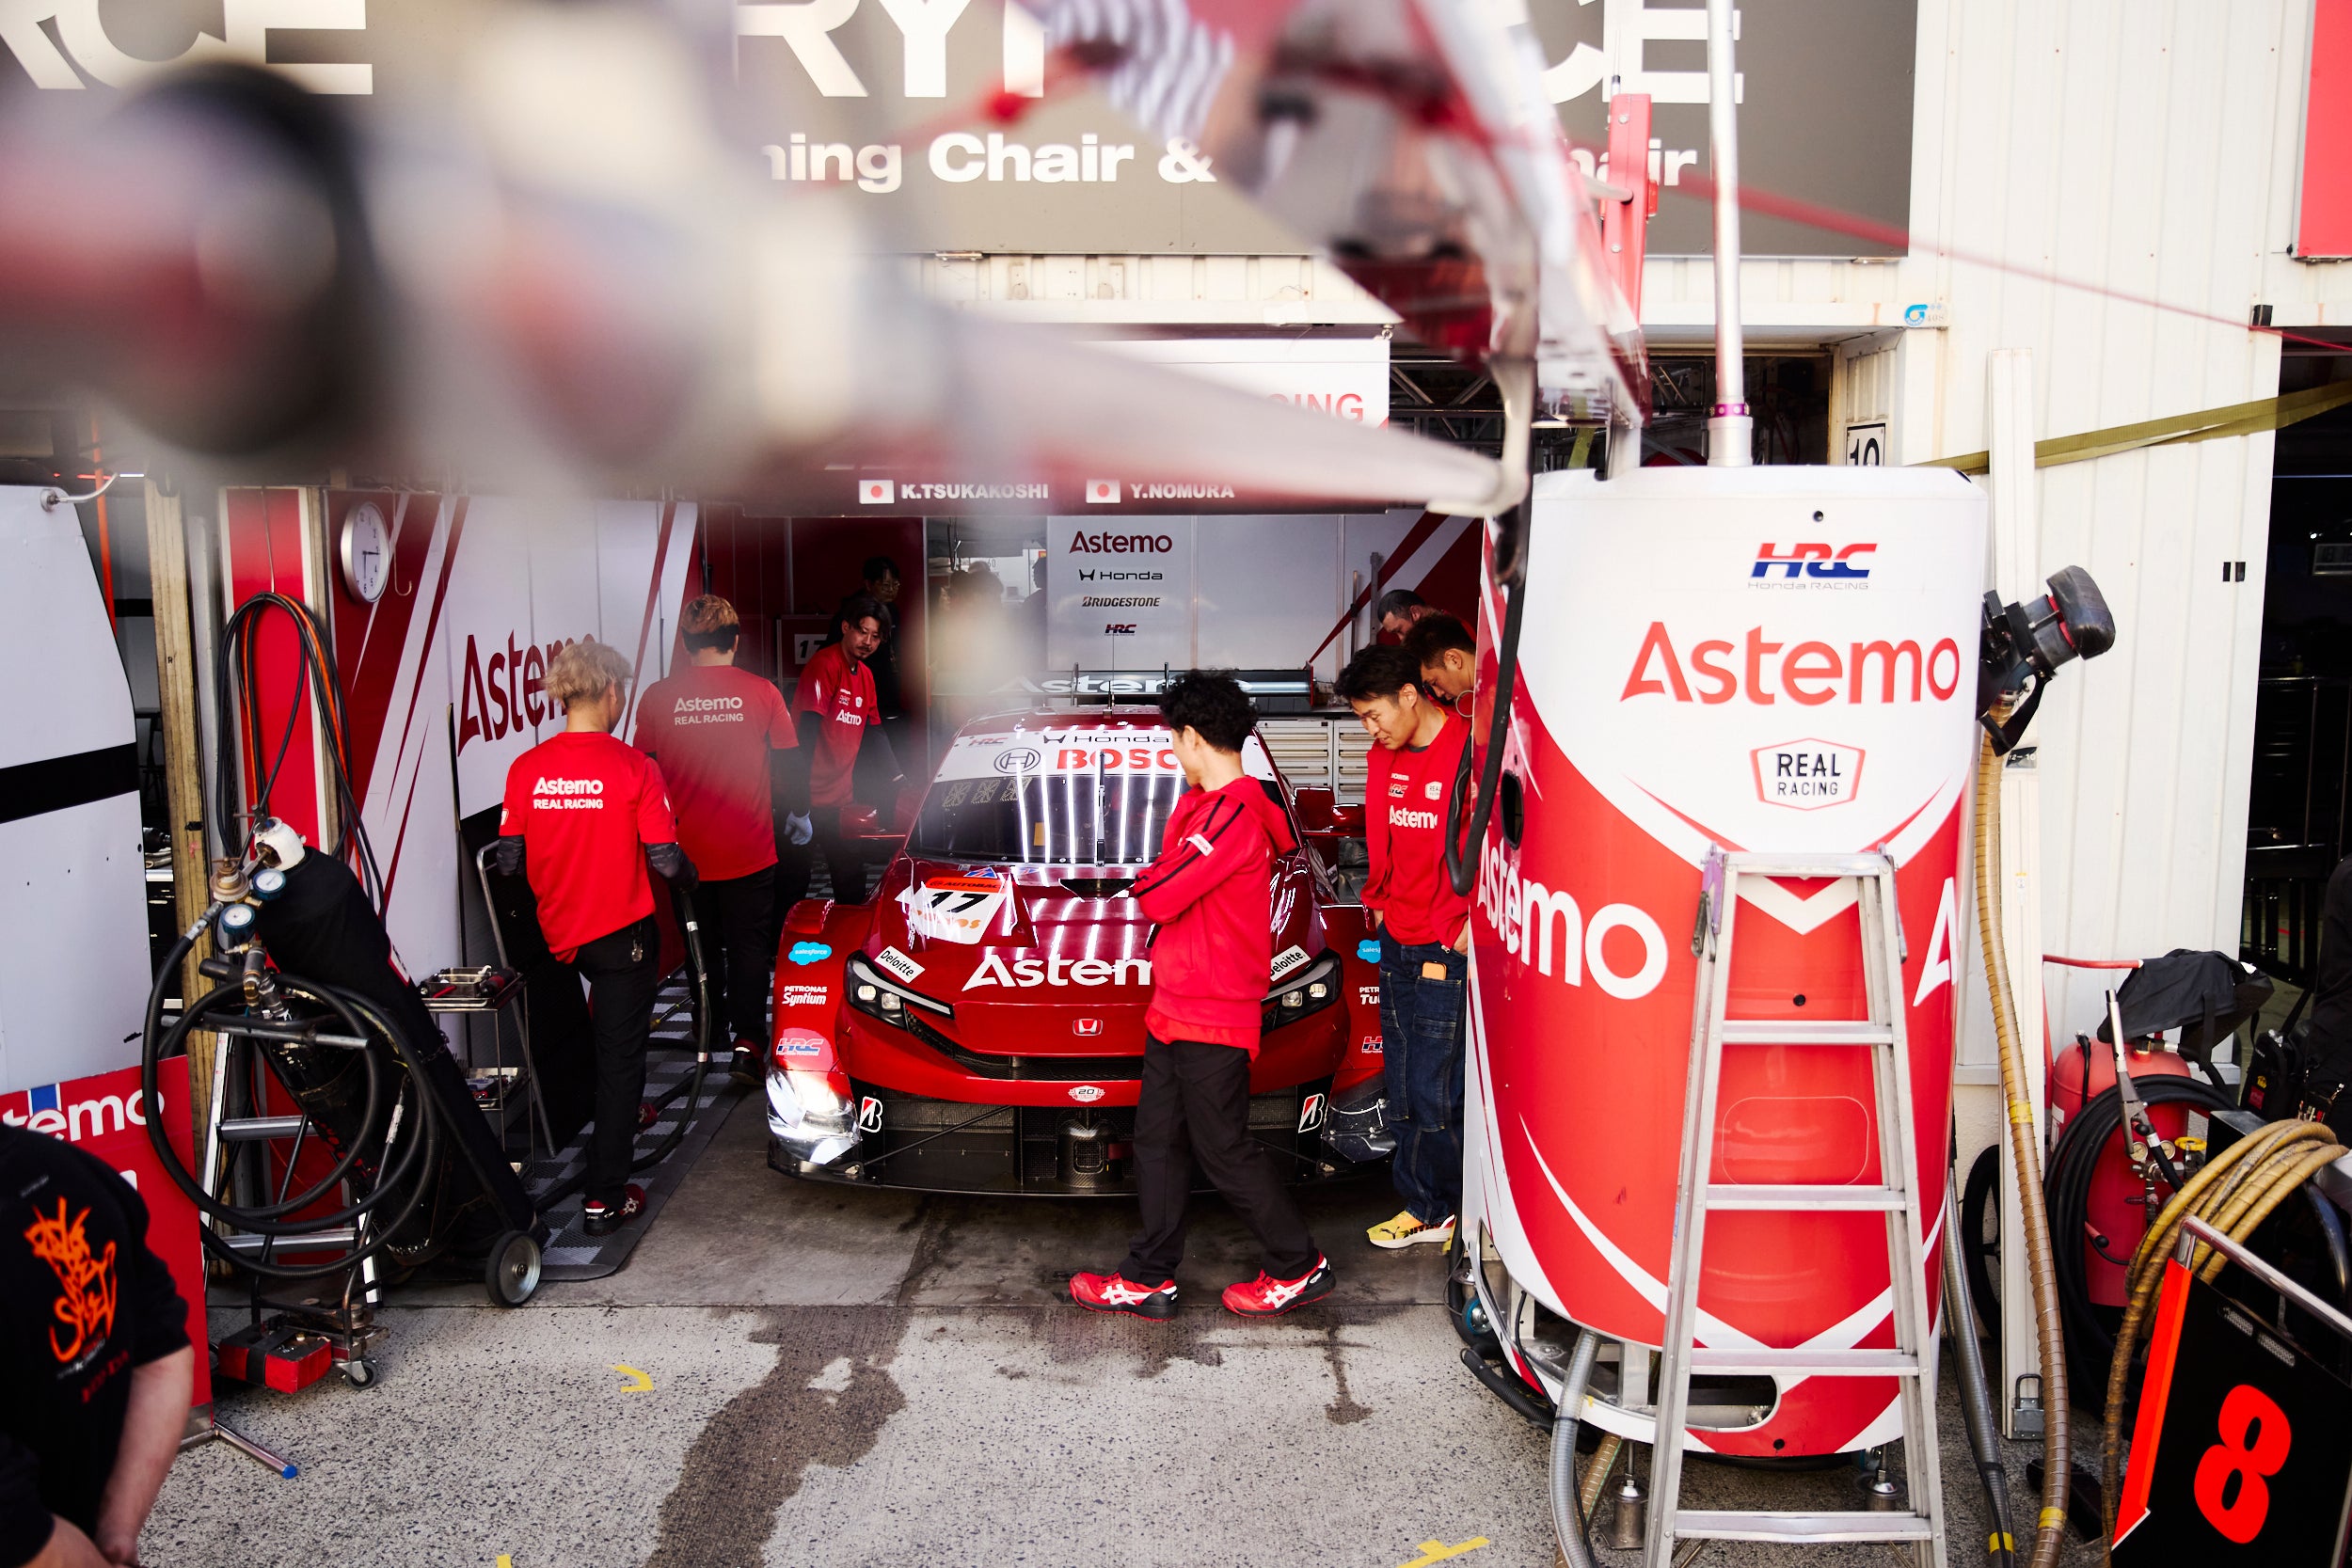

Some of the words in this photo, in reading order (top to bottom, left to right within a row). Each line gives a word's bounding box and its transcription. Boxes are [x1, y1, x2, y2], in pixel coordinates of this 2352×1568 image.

[928, 132, 1136, 182] Chair
[1158, 136, 1218, 183] &
[900, 483, 1049, 499] K.TSUKAKOSHI
[1130, 483, 1235, 499] Y.NOMURA
[1069, 531, 1173, 554] Astemo
[1750, 542, 1878, 578] HRC
[1100, 571, 1163, 580] Honda
[1748, 581, 1806, 591] Honda
[1810, 581, 1869, 591] RACING
[1082, 596, 1161, 608] BRIDGESTONE
[1104, 624, 1137, 634] HRC
[1619, 621, 1961, 706] Astemo
[674, 696, 743, 714] Astemo
[675, 716, 702, 725] REAL
[703, 712, 744, 723] RACING
[1057, 748, 1181, 770] BOSC
[1776, 752, 1841, 777] REAL
[532, 777, 604, 796] Astemo
[1777, 782, 1839, 796] RACING
[533, 799, 564, 810] REAL
[564, 798, 604, 810] RACING
[931, 891, 990, 913] 17
[1477, 825, 1669, 1001] Astemo
[795, 946, 828, 956] salesforce
[782, 991, 827, 1007] Syntium
[1359, 994, 1381, 1006] Tu
[777, 1037, 825, 1053] HRC
[2194, 1384, 2292, 1544] 8
